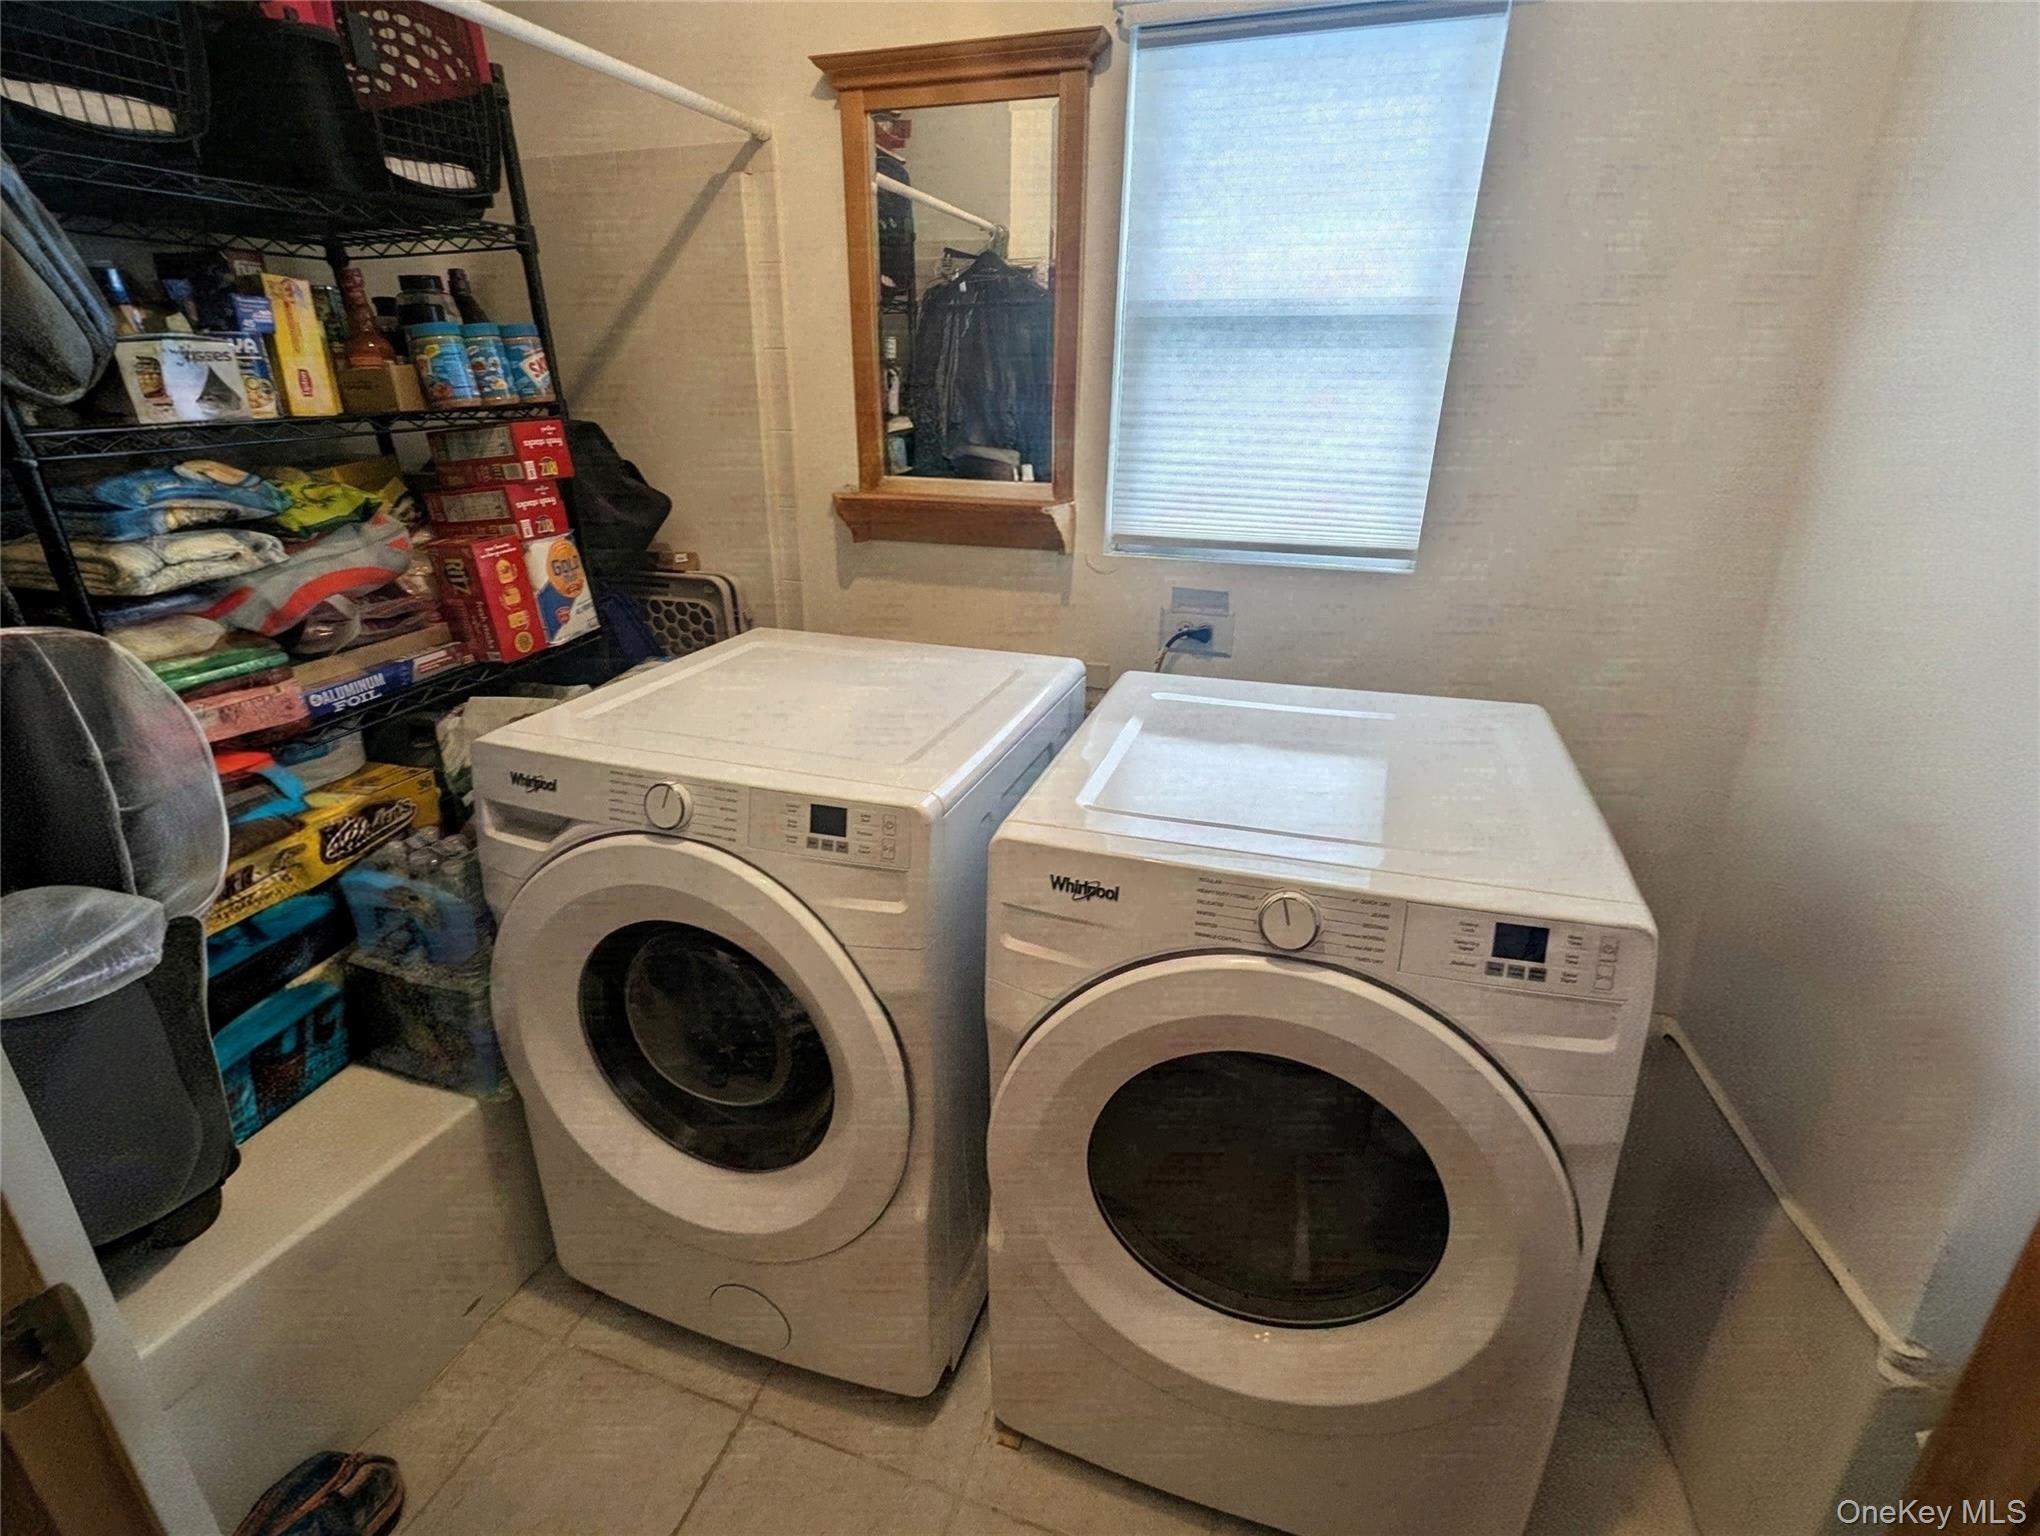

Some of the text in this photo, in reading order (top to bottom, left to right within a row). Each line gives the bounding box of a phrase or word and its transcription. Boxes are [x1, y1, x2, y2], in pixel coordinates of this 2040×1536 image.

[444, 557, 472, 595] RITZ
[321, 672, 386, 704] ALUMINUM
[332, 689, 383, 713] FOIL
[509, 771, 558, 793] Whirlpool
[1050, 874, 1120, 901] Whirlpool
